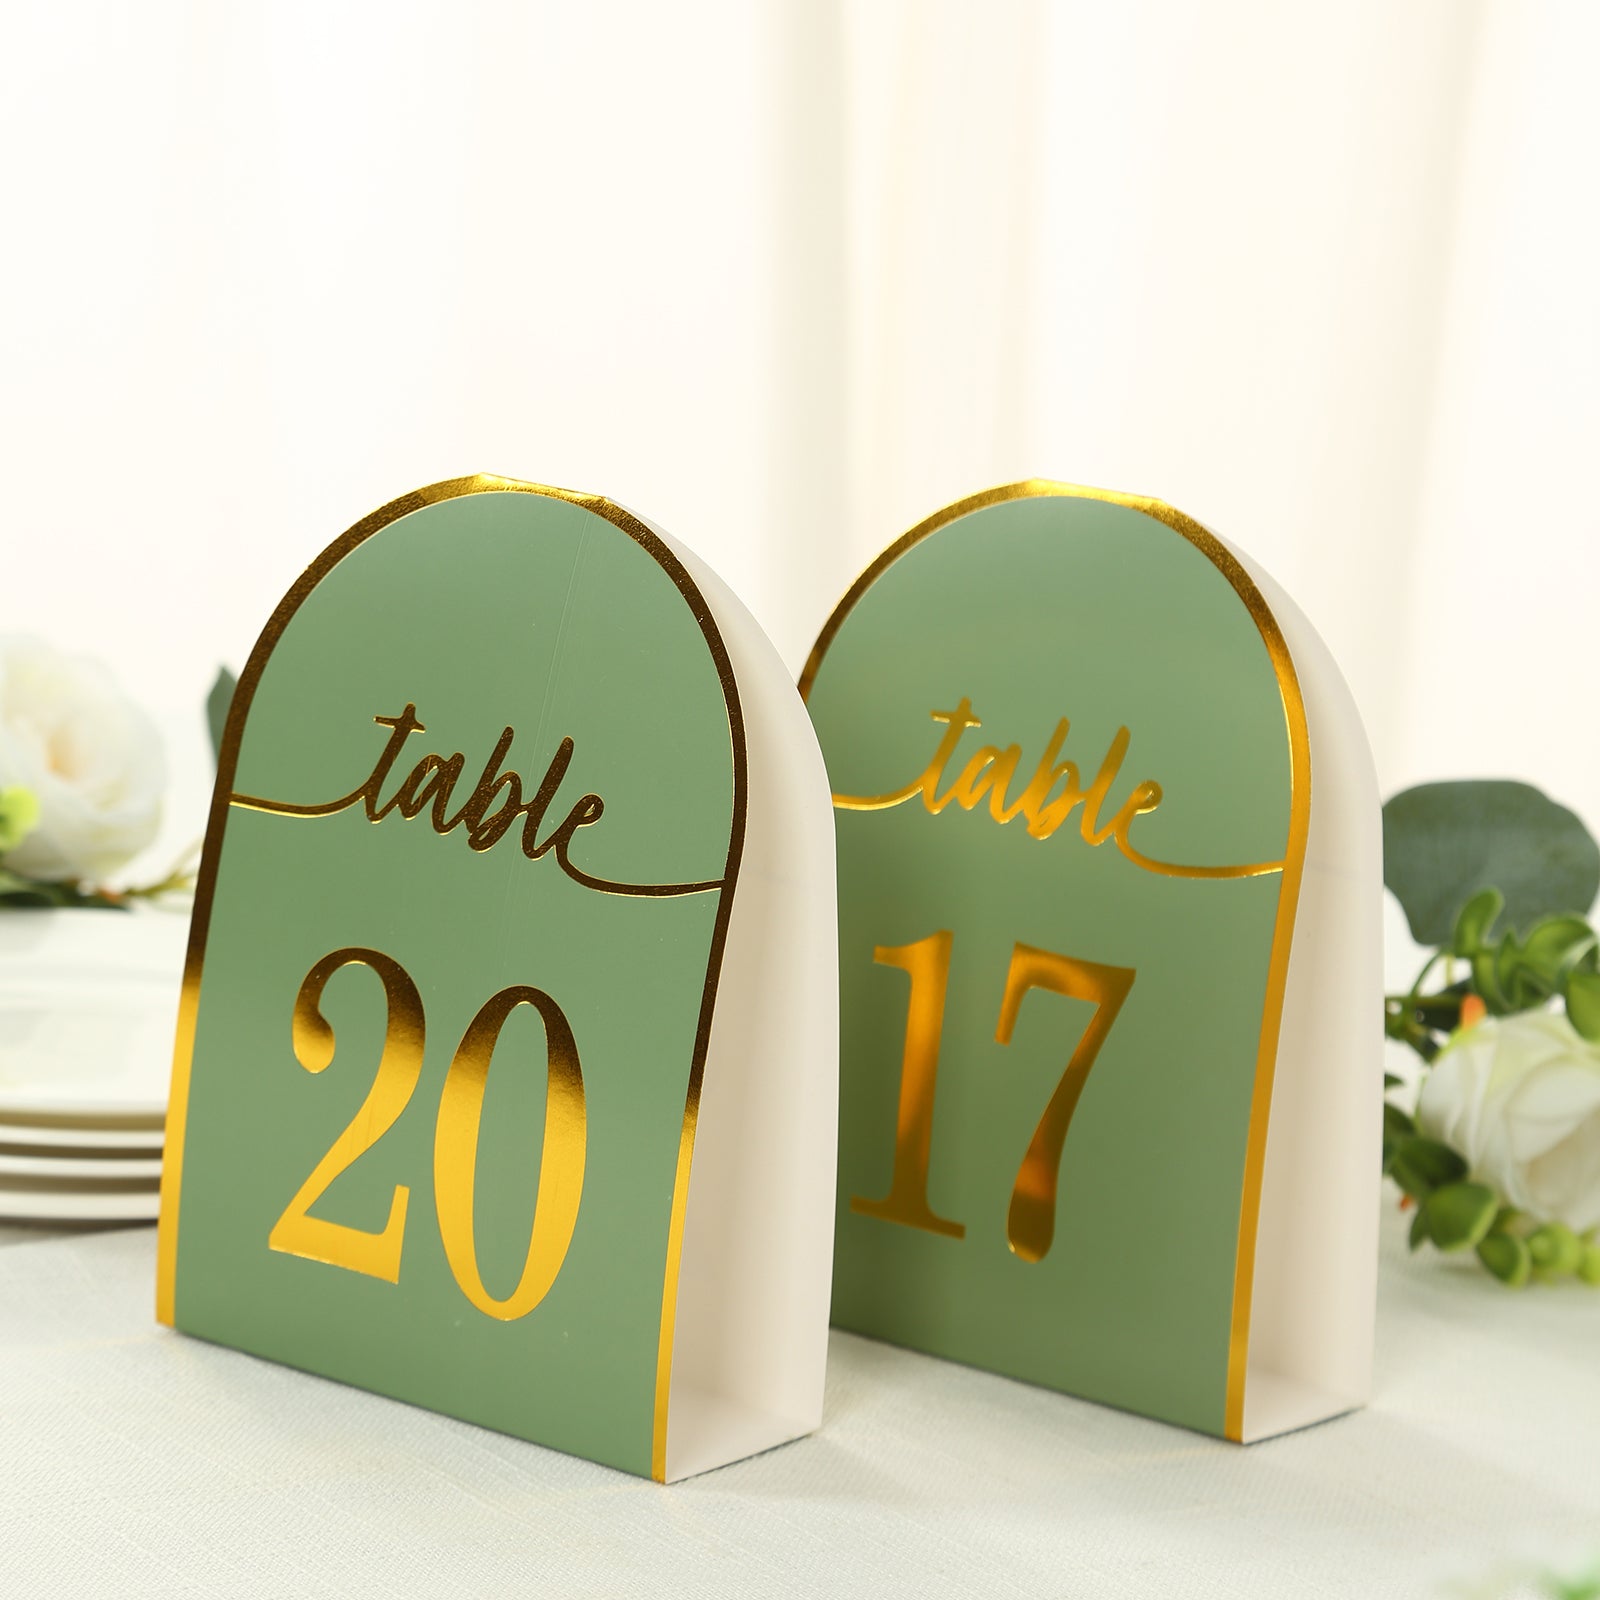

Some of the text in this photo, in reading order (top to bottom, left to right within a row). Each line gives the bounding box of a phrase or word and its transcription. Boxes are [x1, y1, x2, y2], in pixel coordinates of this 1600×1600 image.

[330, 702, 640, 893] table
[896, 696, 1200, 878] table
[268, 946, 587, 1321] 20
[849, 928, 1136, 1264] 17
